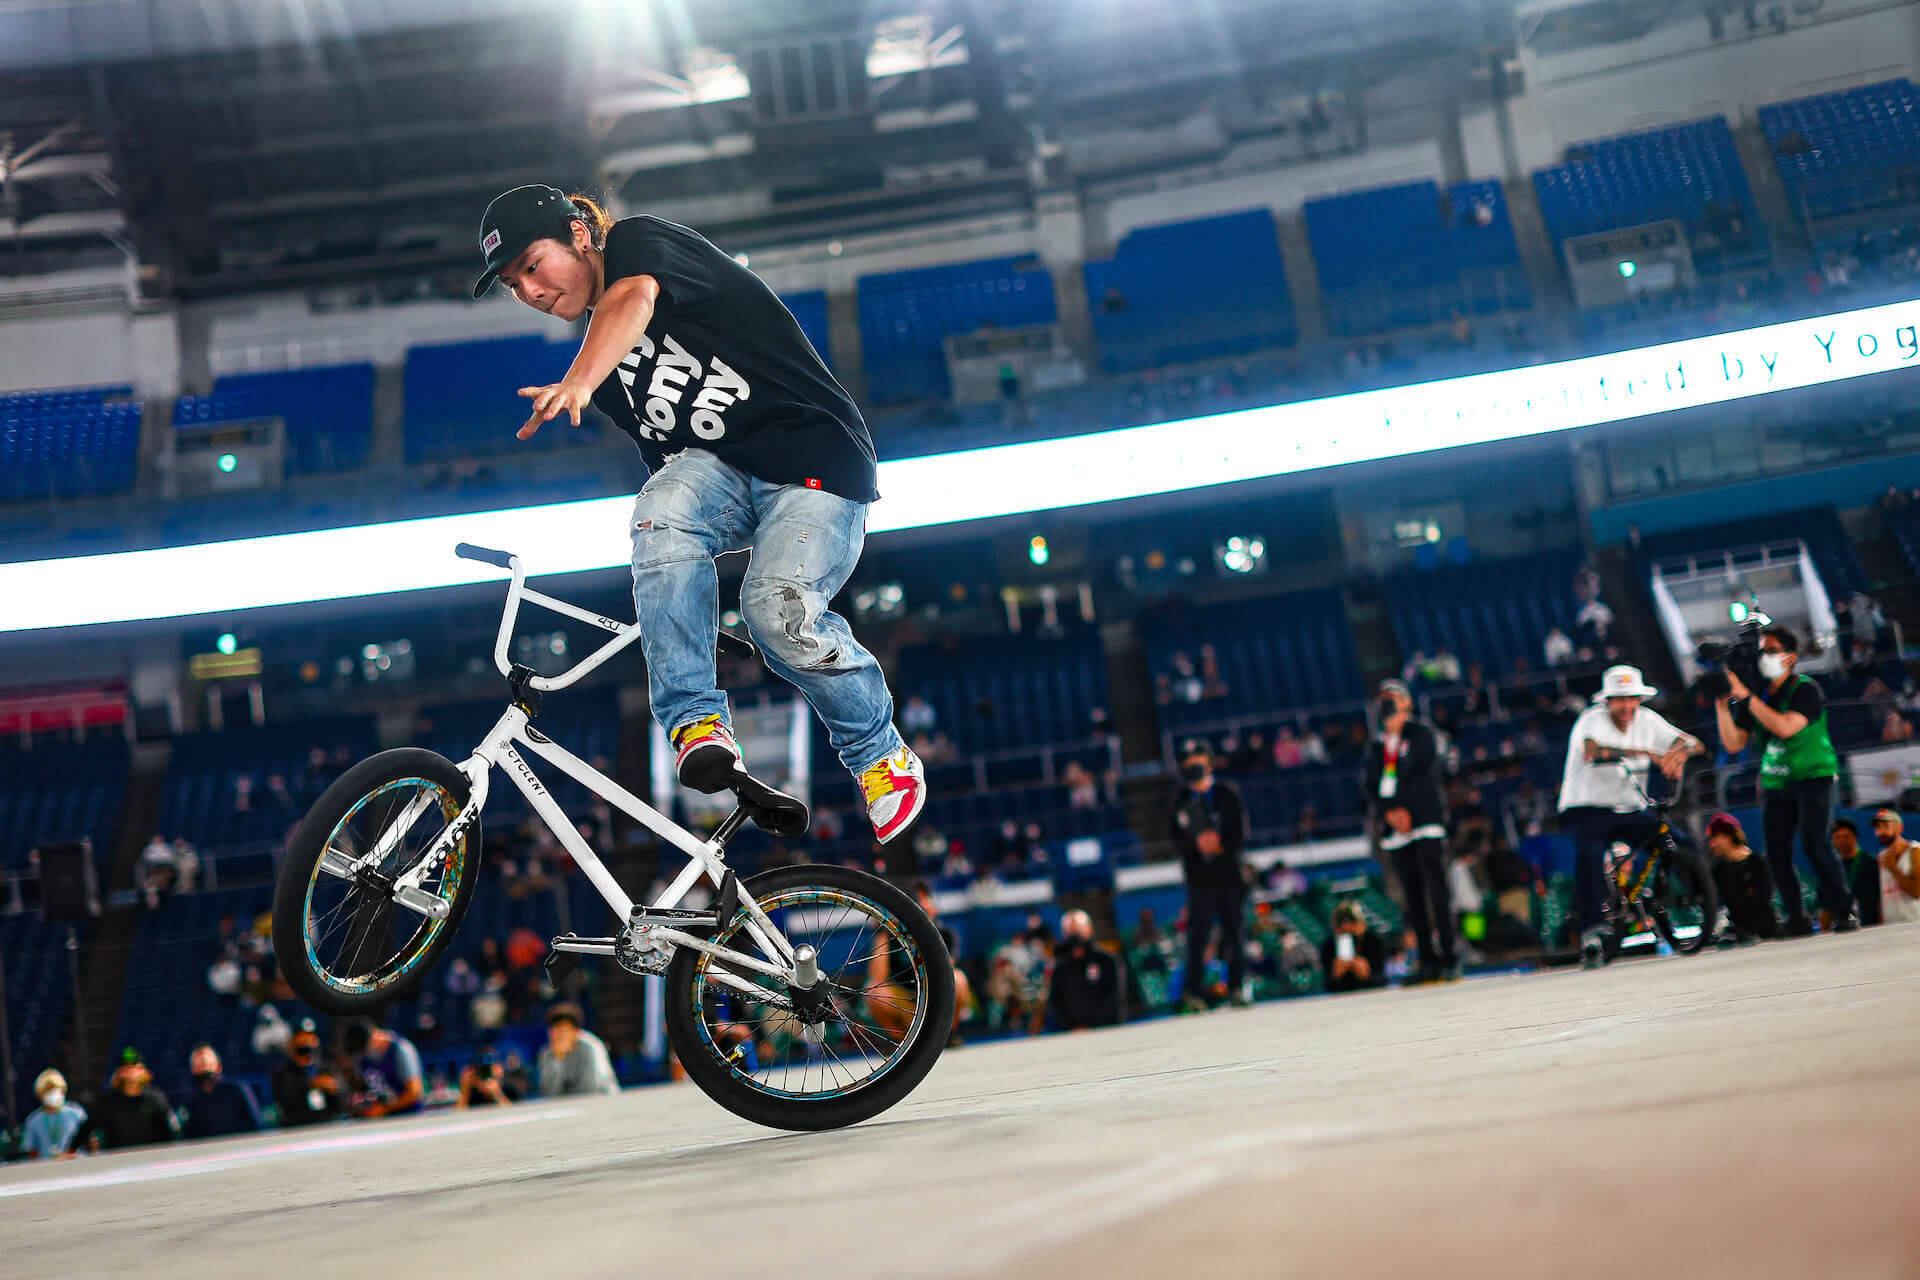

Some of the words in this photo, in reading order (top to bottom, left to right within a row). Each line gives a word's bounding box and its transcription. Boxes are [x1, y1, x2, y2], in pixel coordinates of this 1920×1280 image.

[1720, 351, 1778, 383] by
[1813, 325, 1919, 364] Yog
[810, 478, 818, 487] C
